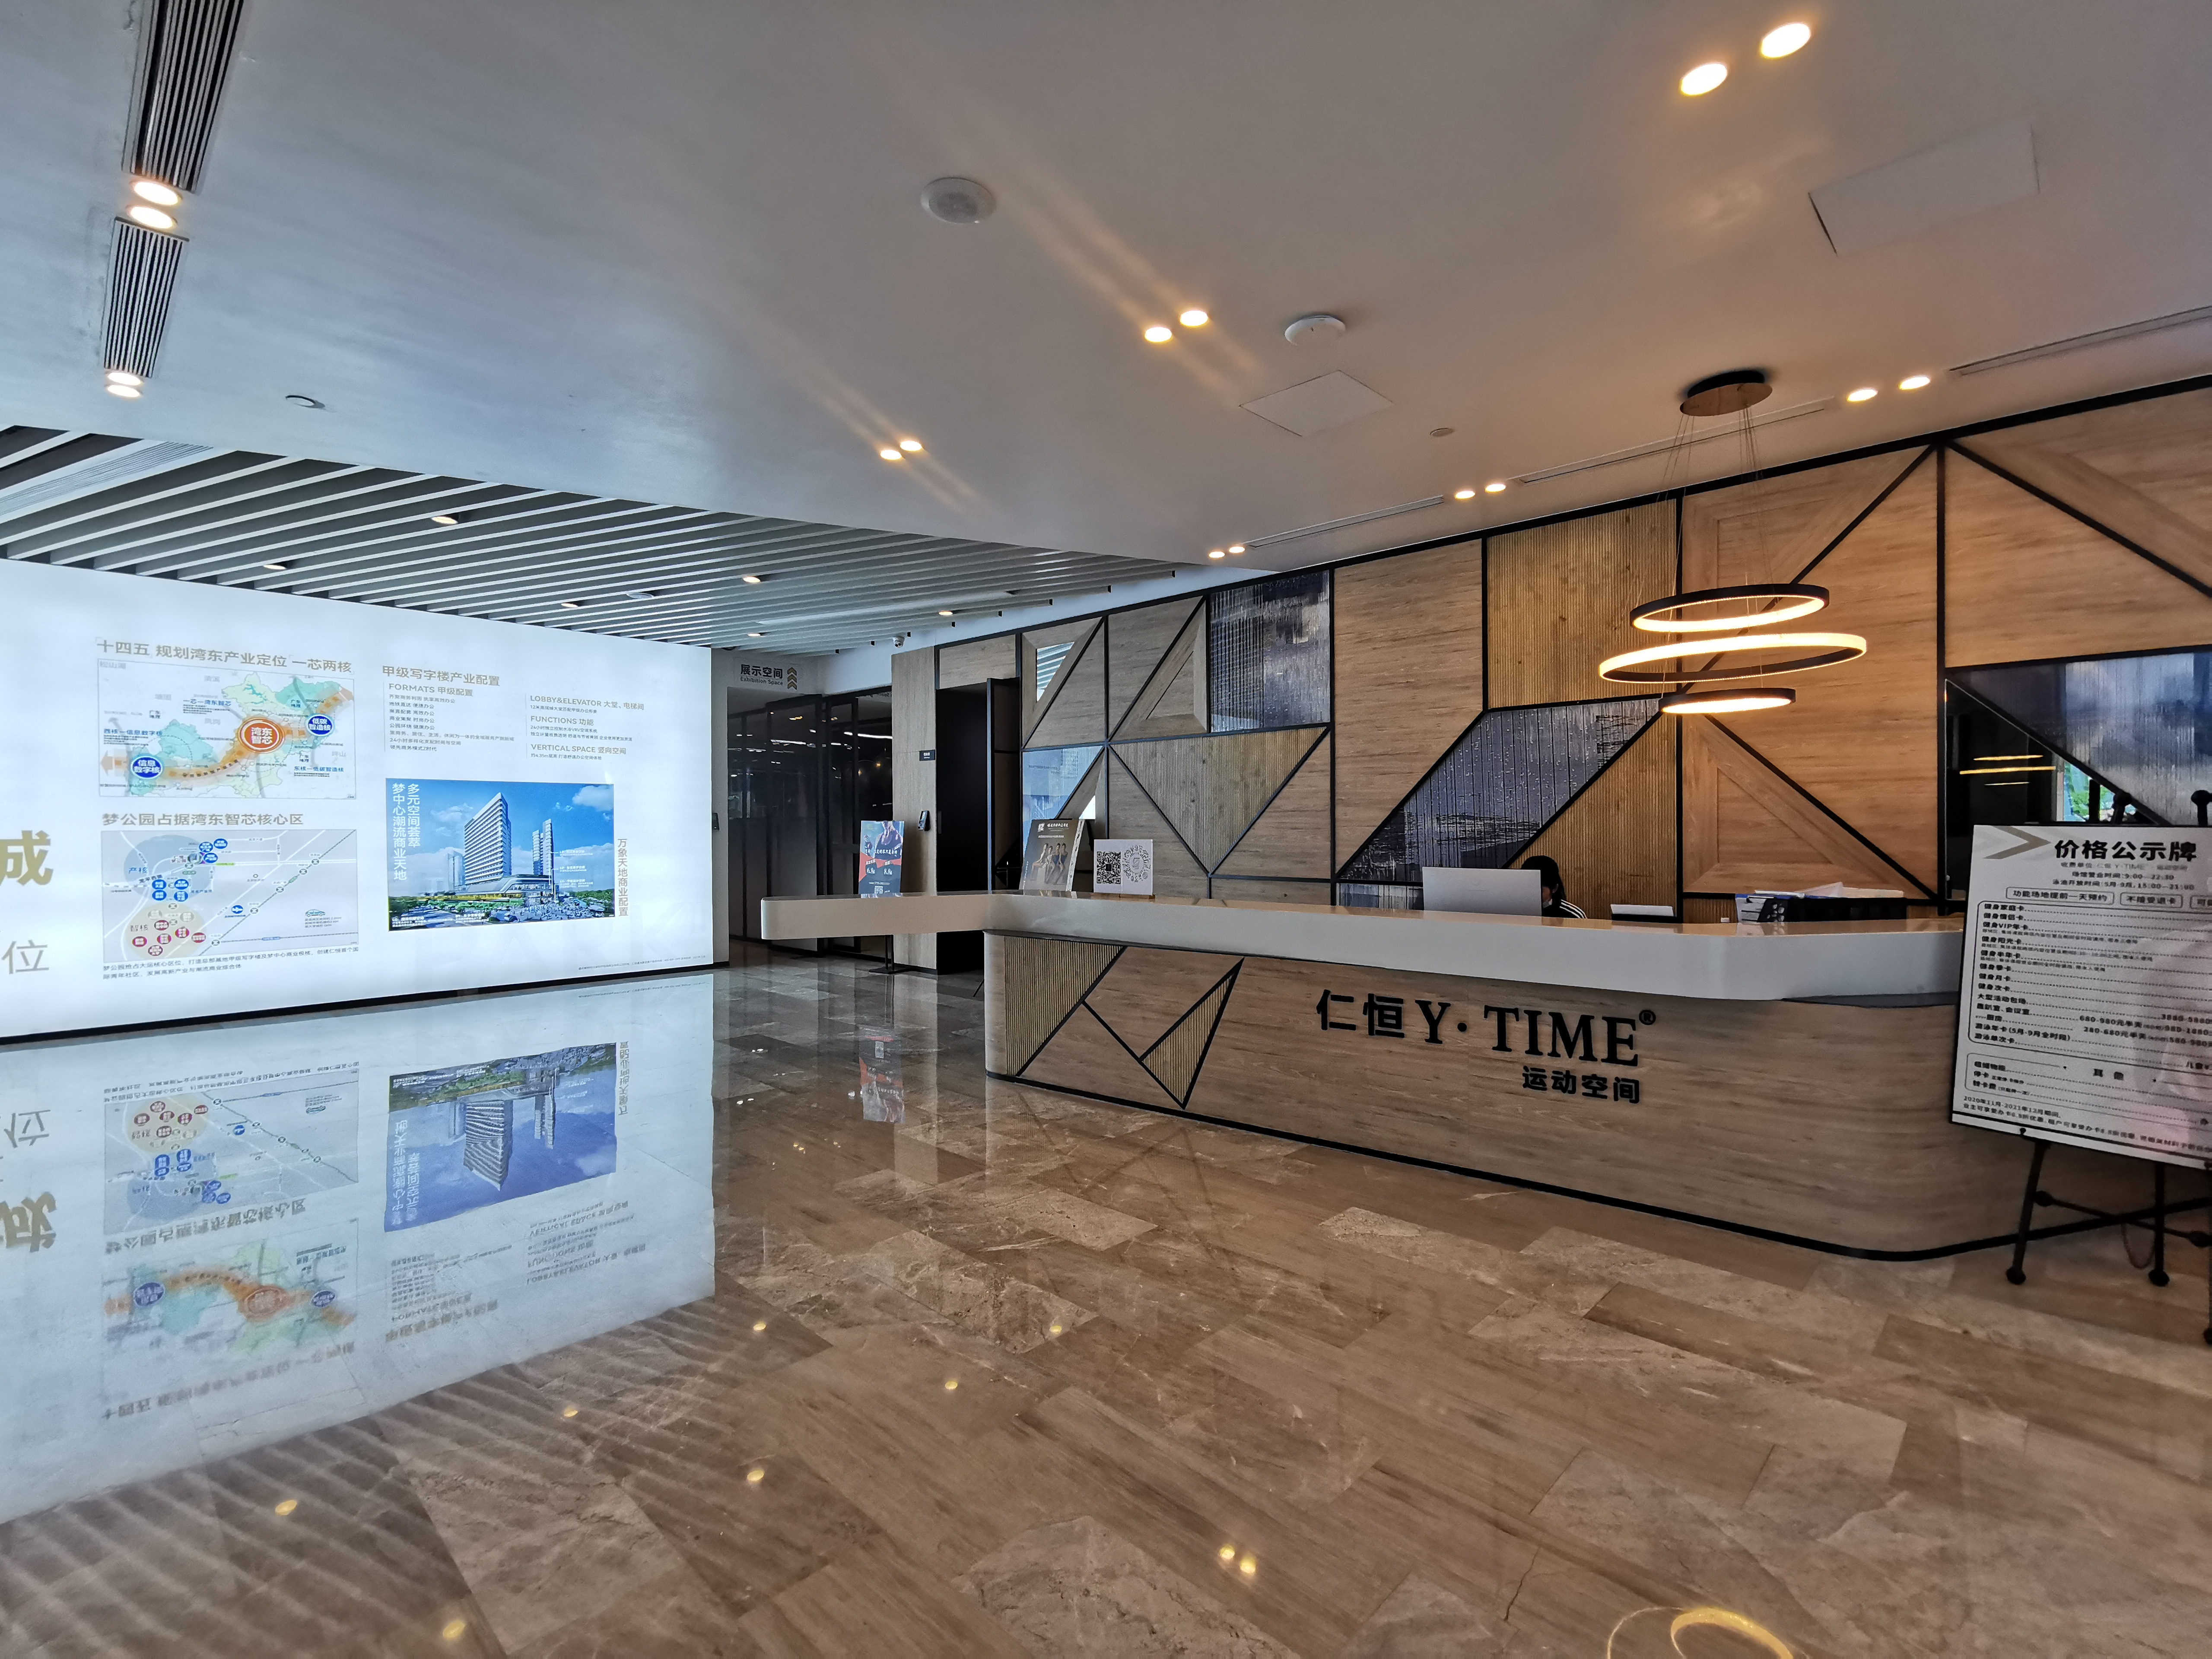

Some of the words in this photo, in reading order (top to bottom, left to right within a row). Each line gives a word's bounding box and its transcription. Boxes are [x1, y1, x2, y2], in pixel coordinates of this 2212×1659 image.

[382, 665, 500, 686] 甲级写字楼产业配置
[741, 664, 783, 679] 展示空间
[389, 683, 435, 693] FORMATS
[438, 686, 473, 697] 甲级配置
[530, 695, 602, 706] LOBBY&ELEVATOR
[531, 715, 577, 725] FUNCTIONS
[251, 727, 273, 736] 湾东
[251, 736, 273, 745] 智芯
[102, 813, 303, 826] 梦公园占据湾东智芯核心区
[407, 783, 420, 848] 多元空间荟萃
[392, 782, 407, 880] 梦中心潮流商业天地
[2054, 839, 2197, 862] 价格公示牌
[617, 839, 629, 916] 万象天地商业配置
[1, 939, 49, 974] 位
[1316, 989, 1405, 1038] 仁恒
[1522, 1065, 1640, 1104] 运动空间
